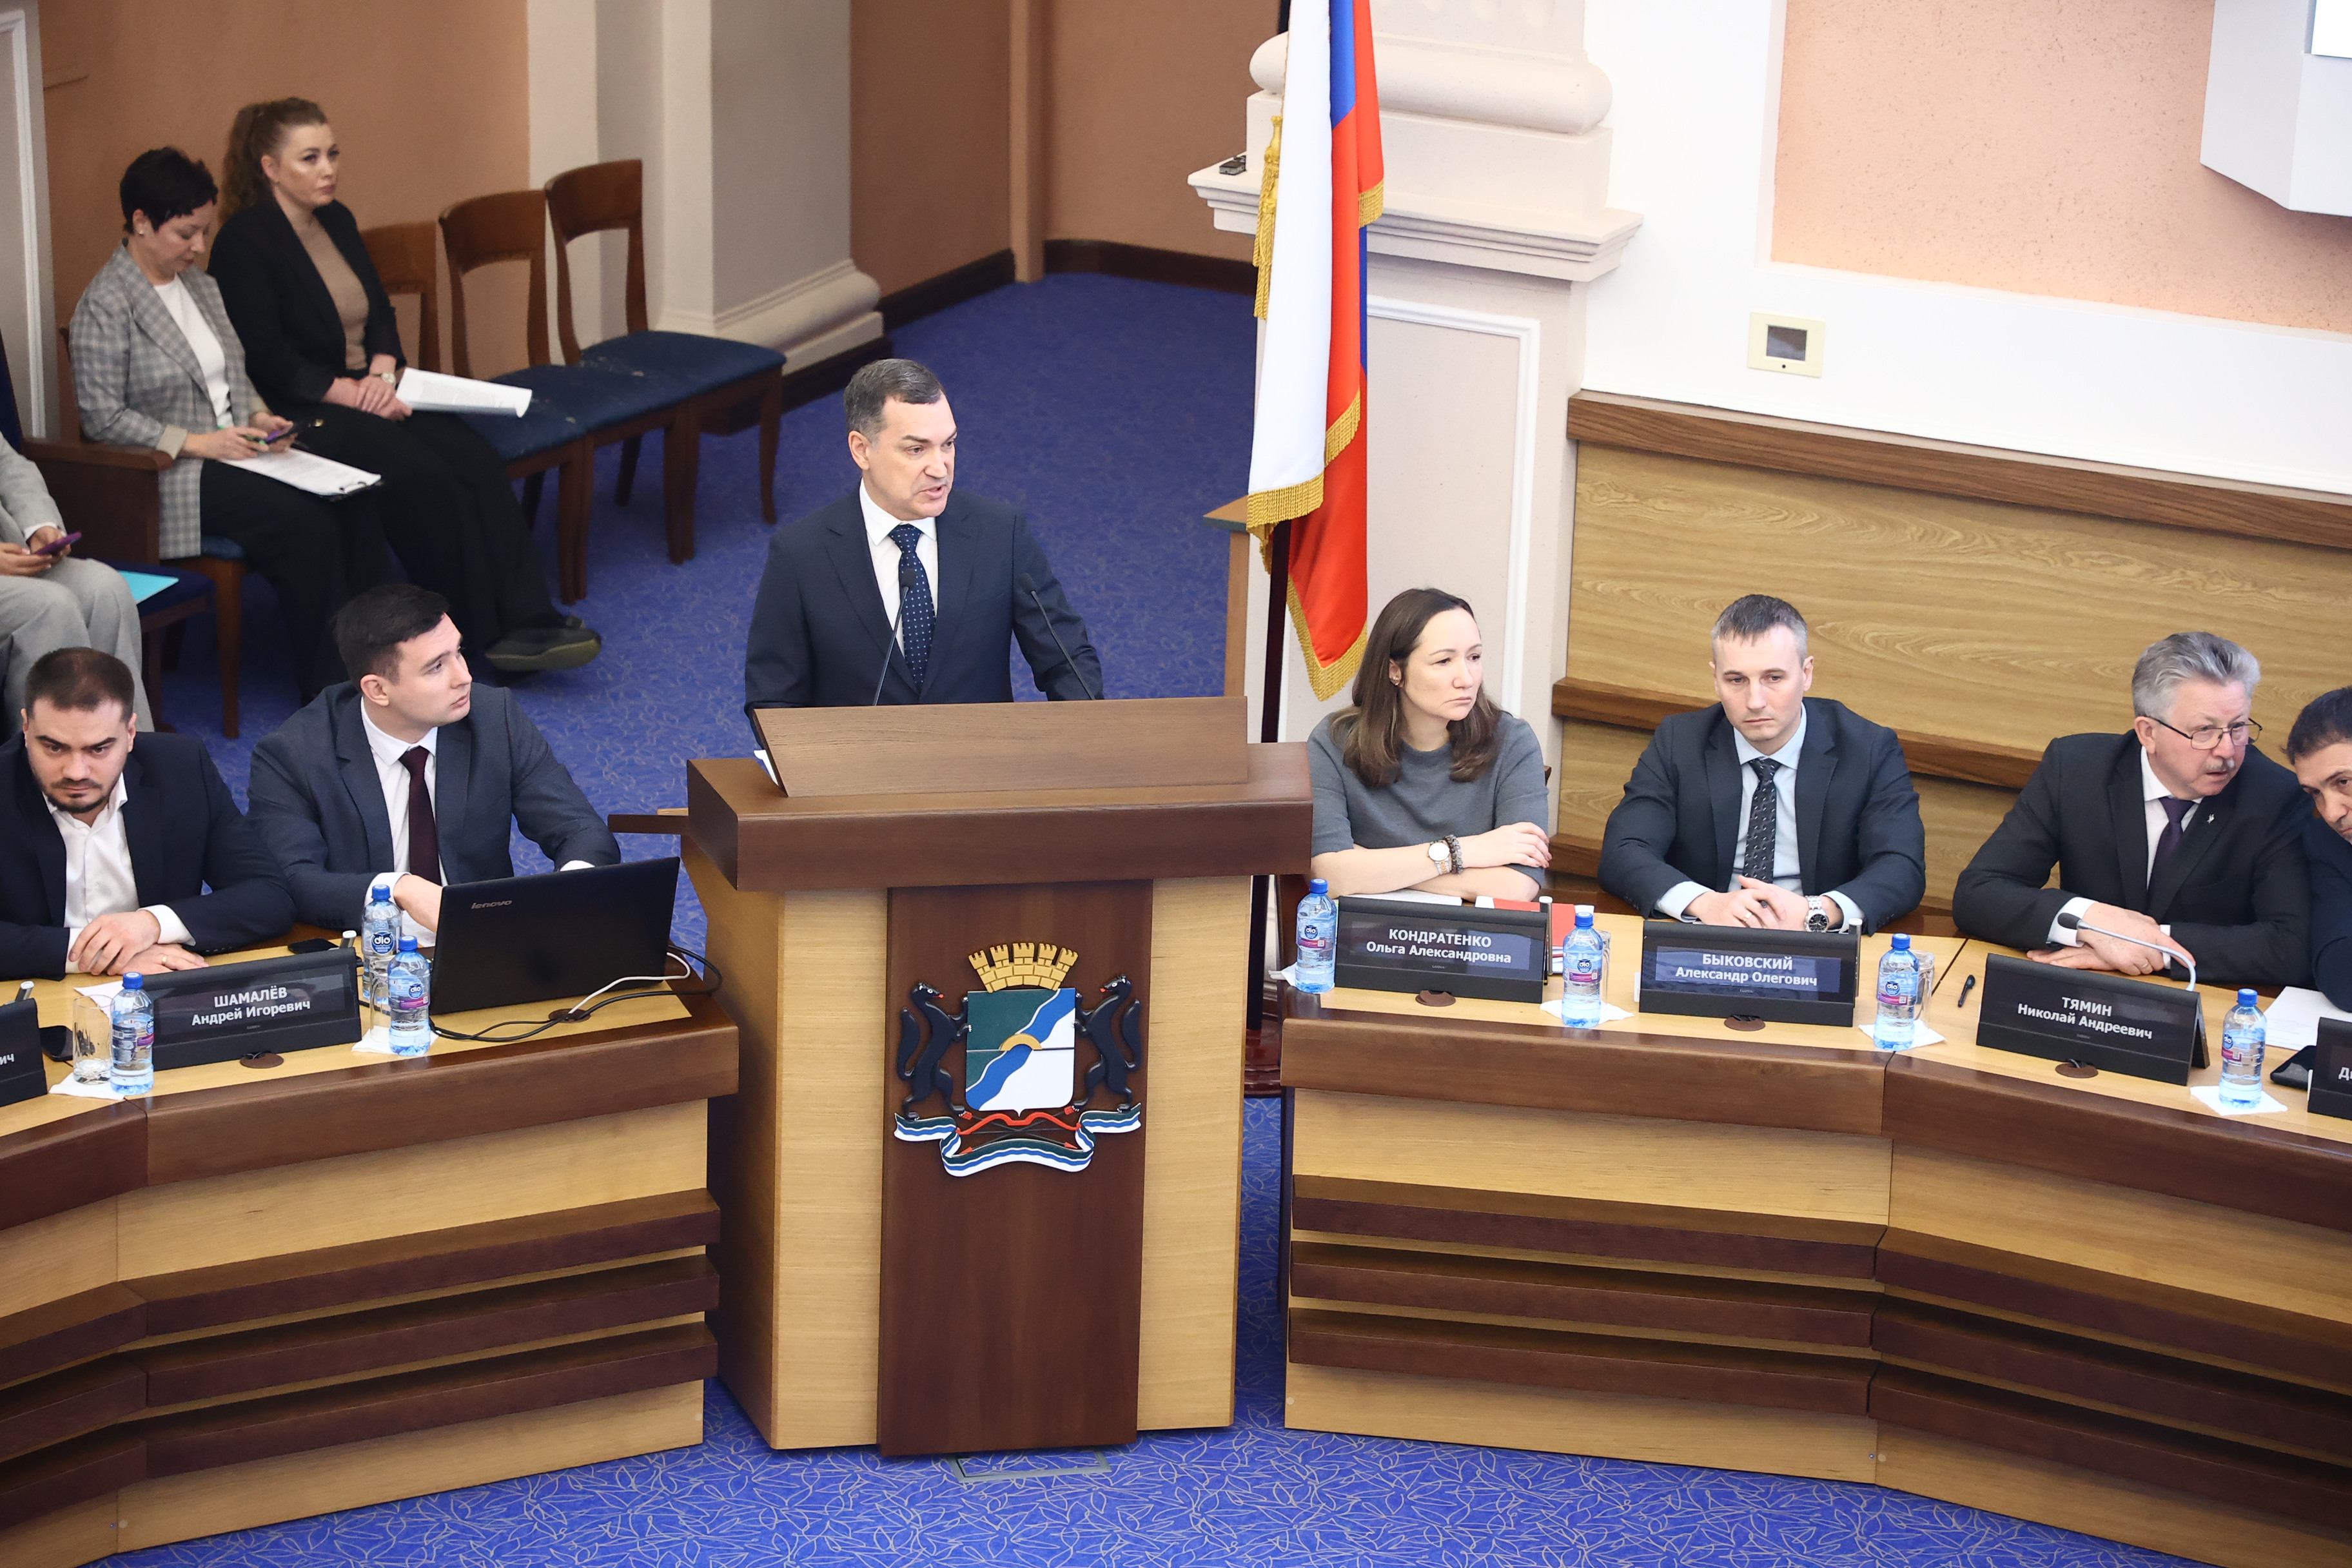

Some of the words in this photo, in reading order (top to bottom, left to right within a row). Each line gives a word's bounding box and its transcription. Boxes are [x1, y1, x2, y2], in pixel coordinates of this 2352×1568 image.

[471, 900, 513, 910] lenovo
[374, 936, 391, 945] dio
[1389, 928, 1492, 948] КОНДРАТЕНКО
[1366, 941, 1406, 954] Ольга
[1409, 945, 1512, 963] Александровна
[1702, 954, 1793, 970] БЫКОВСКИЙ
[1675, 966, 1749, 983] Александр
[1752, 971, 1818, 986] Олегович
[213, 985, 288, 1008] ШАМАЛЁВ
[2062, 996, 2112, 1017] ТЯМИН
[191, 1008, 242, 1025] Андрей
[246, 1001, 310, 1017] Игоревич
[2017, 1003, 2076, 1024] Николай
[2079, 1015, 2153, 1039] Андреевич
